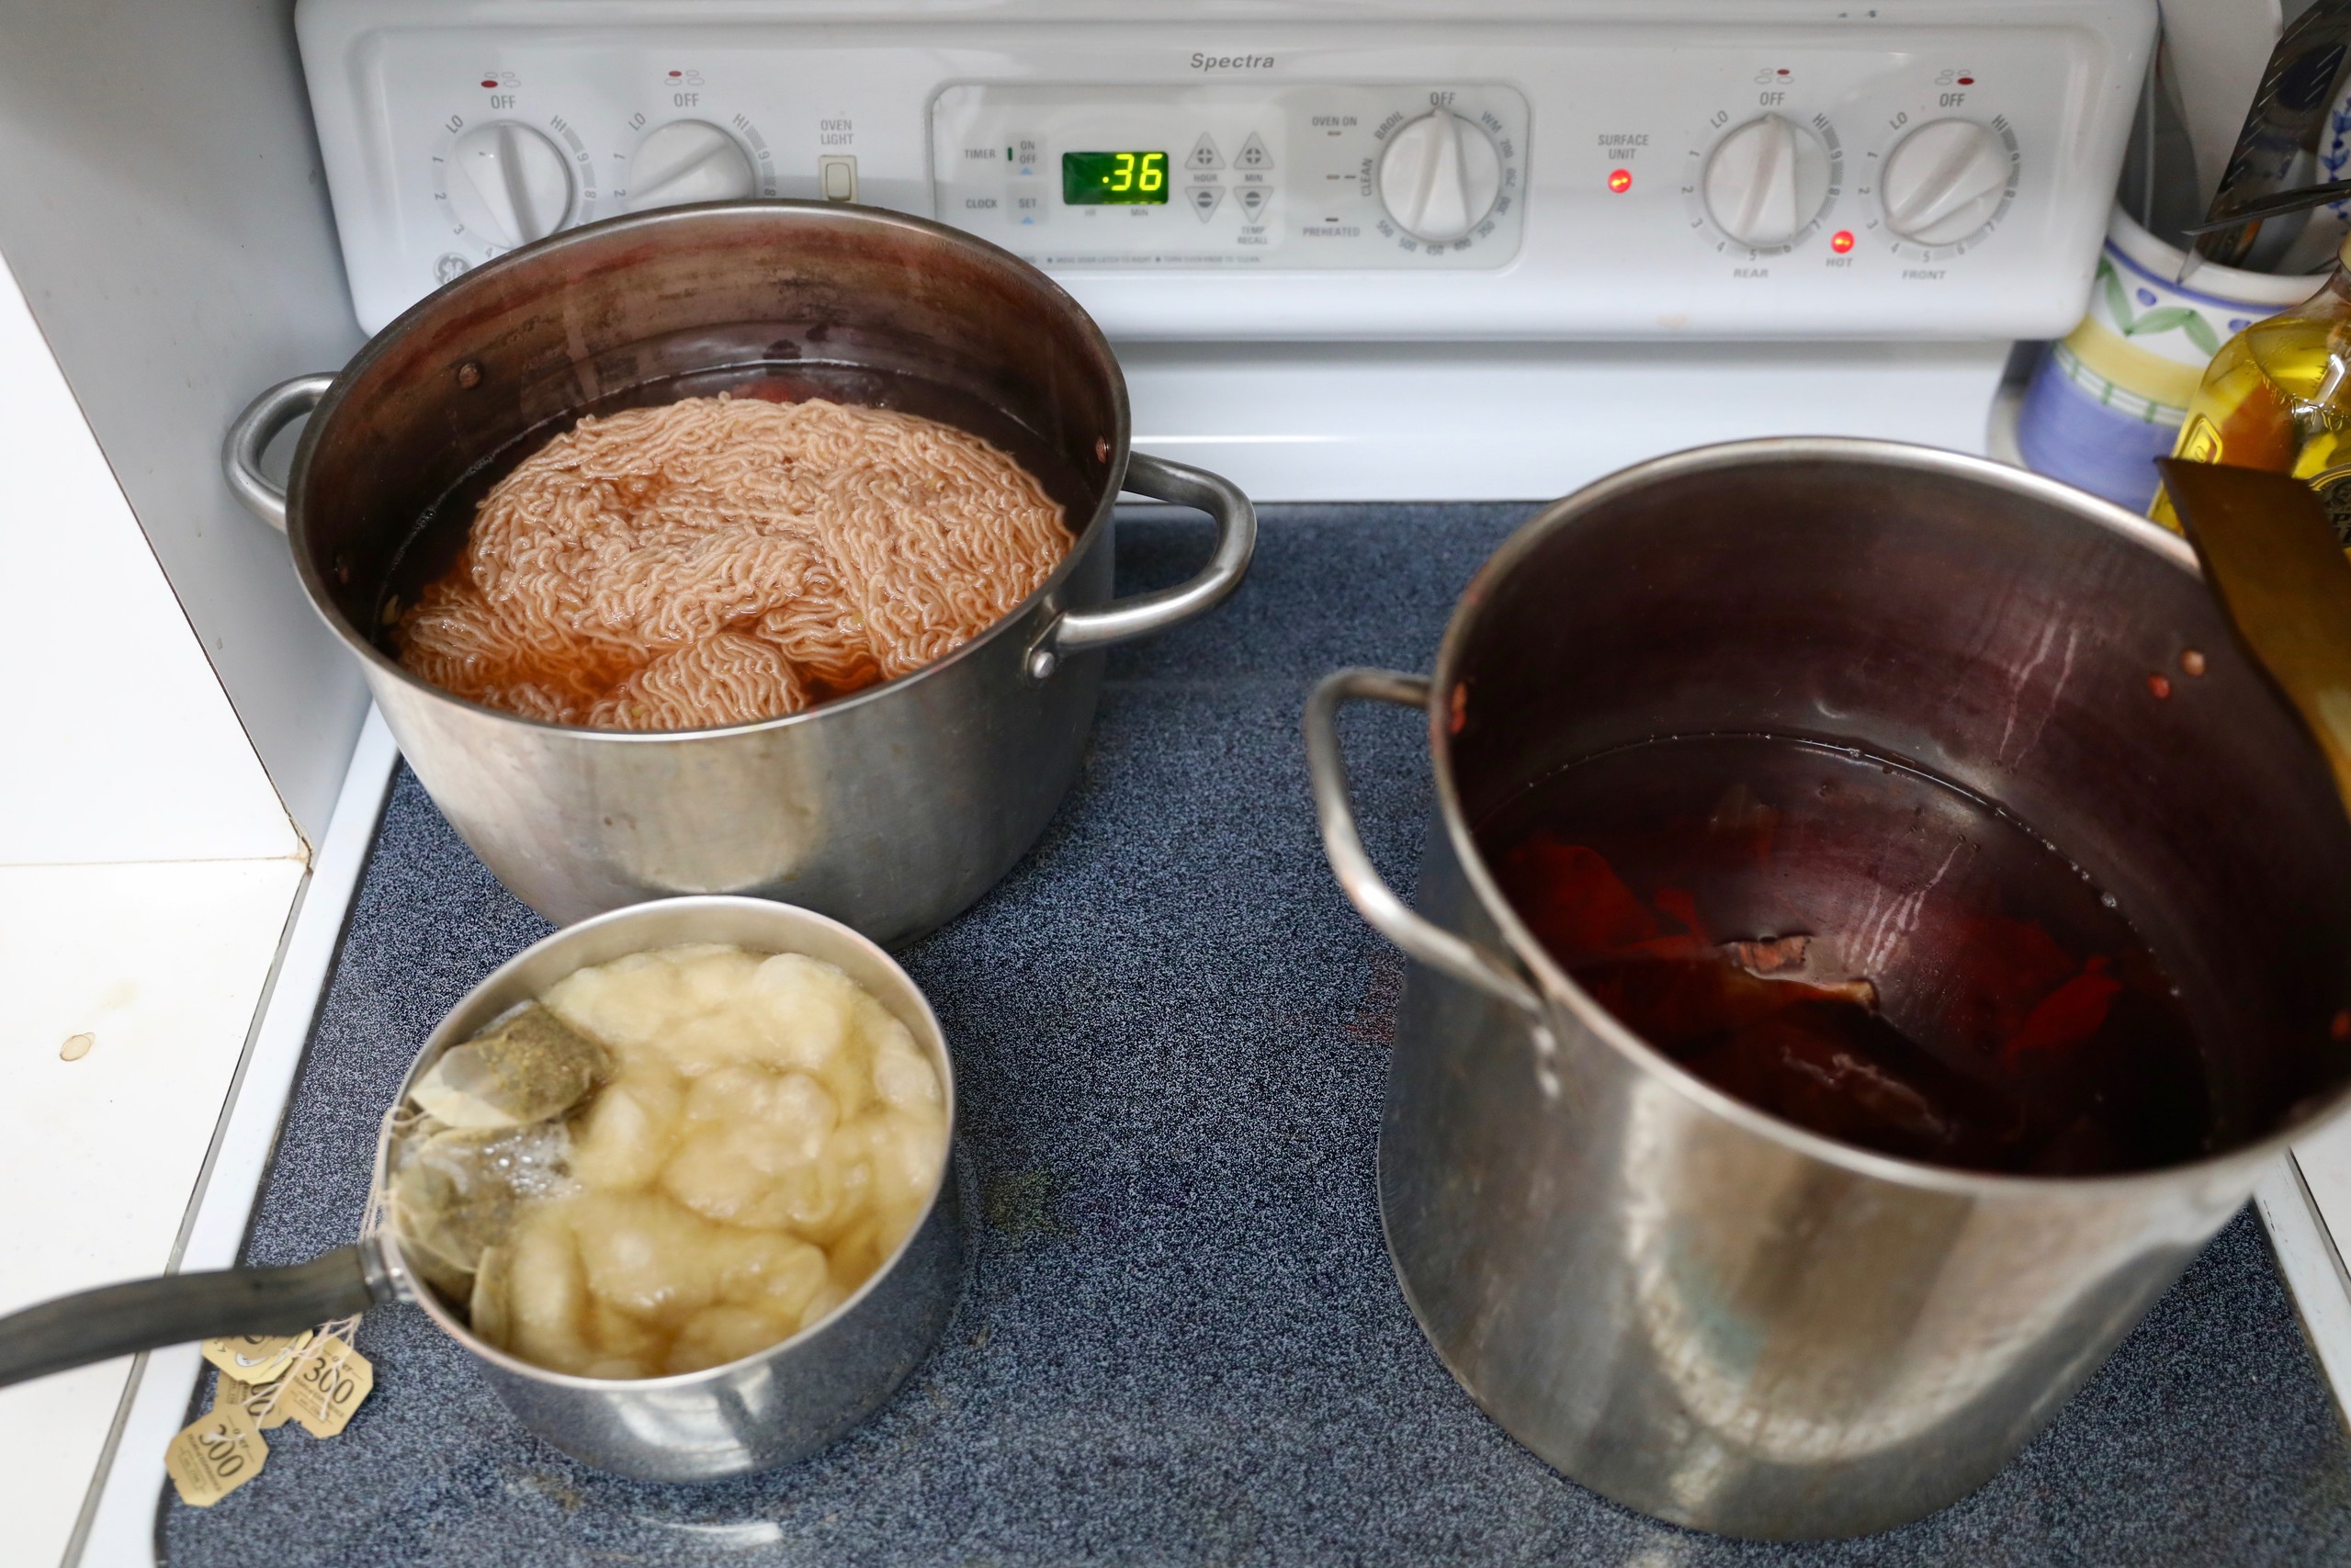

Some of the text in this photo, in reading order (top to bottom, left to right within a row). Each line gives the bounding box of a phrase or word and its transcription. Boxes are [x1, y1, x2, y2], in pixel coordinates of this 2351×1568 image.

[1191, 52, 1274, 72] Spectra
[491, 95, 516, 109] OFF
[673, 93, 699, 107] OFF
[1430, 92, 1456, 106] OFF
[1759, 92, 1785, 106] OFF
[1939, 93, 1965, 107] OFF
[446, 115, 463, 134] LO
[550, 115, 567, 133] HI
[628, 112, 646, 131] LO
[732, 113, 749, 130] HI
[820, 119, 852, 130] OVEN
[1312, 117, 1358, 127] OVEN ON
[1374, 111, 1405, 140] BROIL
[1481, 111, 1502, 134] WM
[1710, 110, 1729, 130] LO
[1813, 113, 1828, 130] HI
[1890, 111, 1908, 130] LO
[1992, 114, 2008, 131] HI
[820, 133, 854, 145] LIGHT
[1020, 141, 1035, 150] ON
[1598, 135, 1649, 146] SURFACE
[965, 149, 996, 159] TIMER
[1019, 154, 1037, 164] OFF
[1609, 149, 1636, 160] UNIT
[1361, 158, 1373, 197] CLEAN
[966, 198, 998, 209] CLOCK
[1019, 198, 1036, 208] SET
[1131, 209, 1148, 217] MIN
[1303, 227, 1361, 237] PREHEATED
[1825, 258, 1853, 267] HOT
[1734, 268, 1769, 277] REAR
[1902, 270, 1946, 280] FRONT
[332, 1355, 354, 1371] oer
[303, 1357, 355, 1404] 300
[233, 1428, 250, 1449] oer
